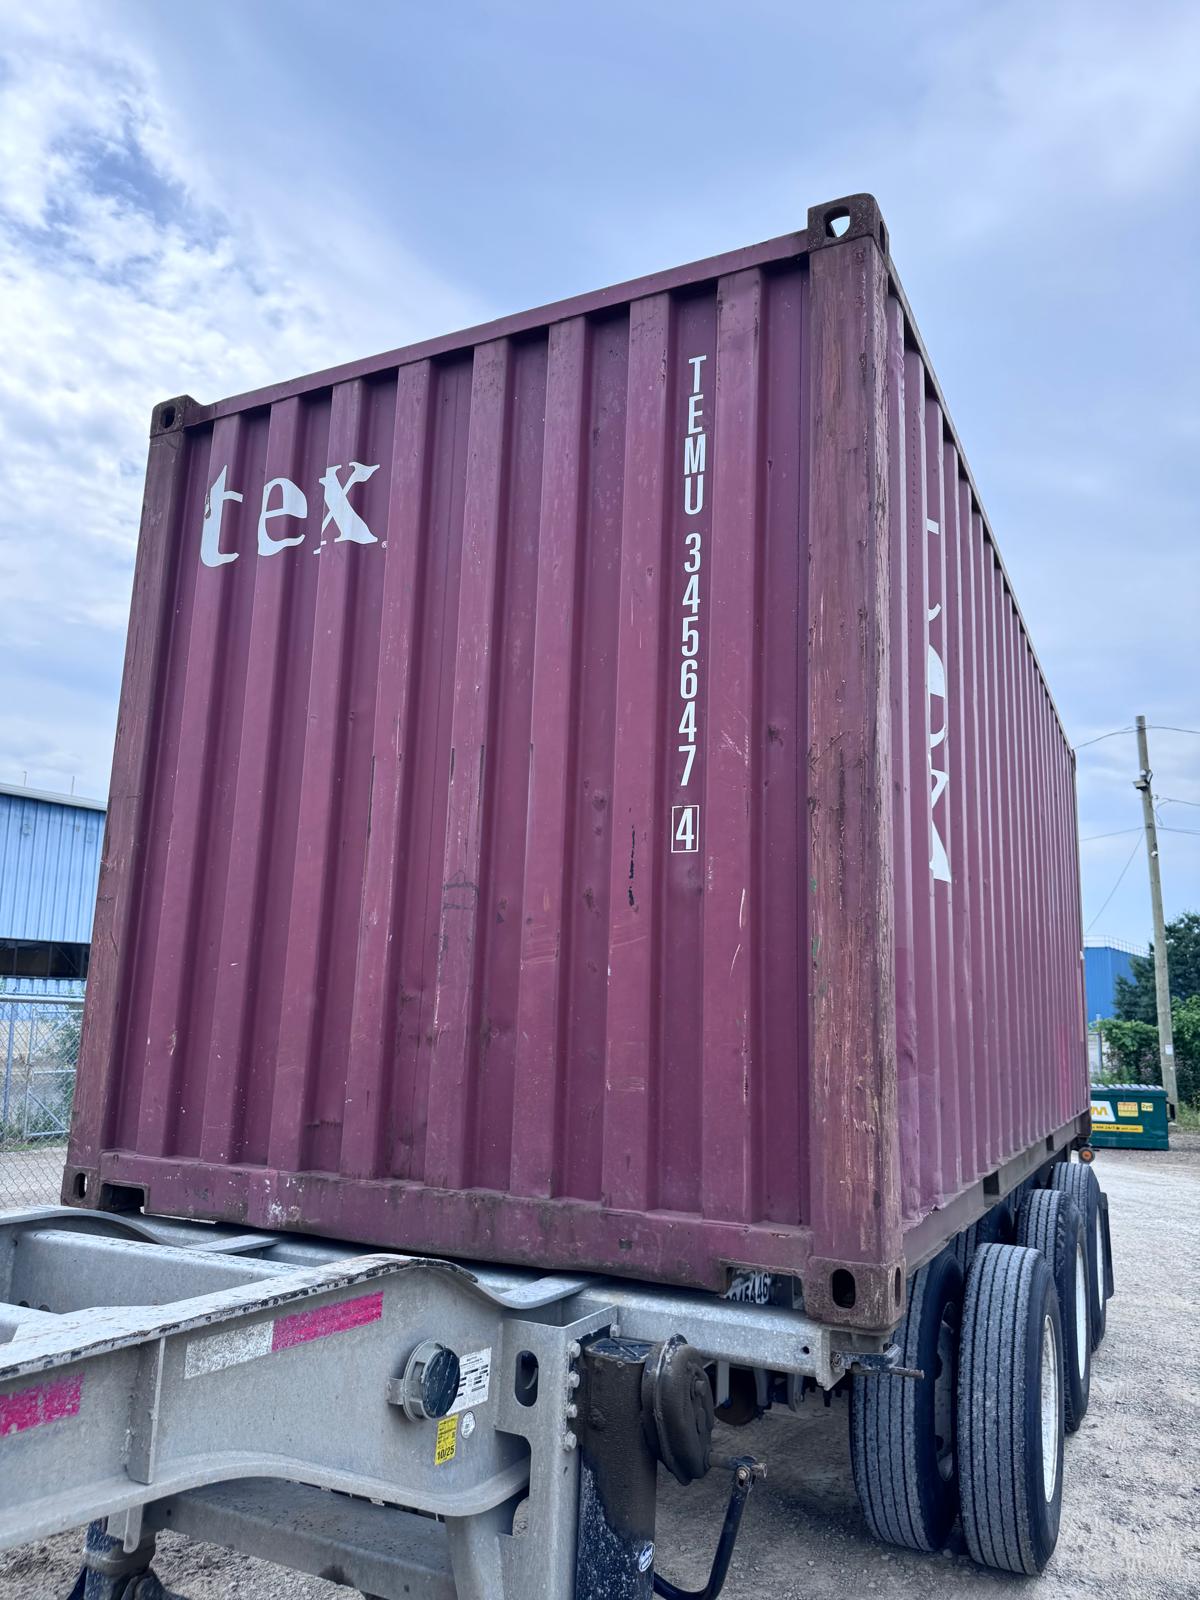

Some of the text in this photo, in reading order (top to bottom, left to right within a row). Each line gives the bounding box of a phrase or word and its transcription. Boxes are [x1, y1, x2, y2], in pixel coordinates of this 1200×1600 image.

[200, 461, 380, 568] tex
[675, 355, 706, 850] TEMU 345647 4
